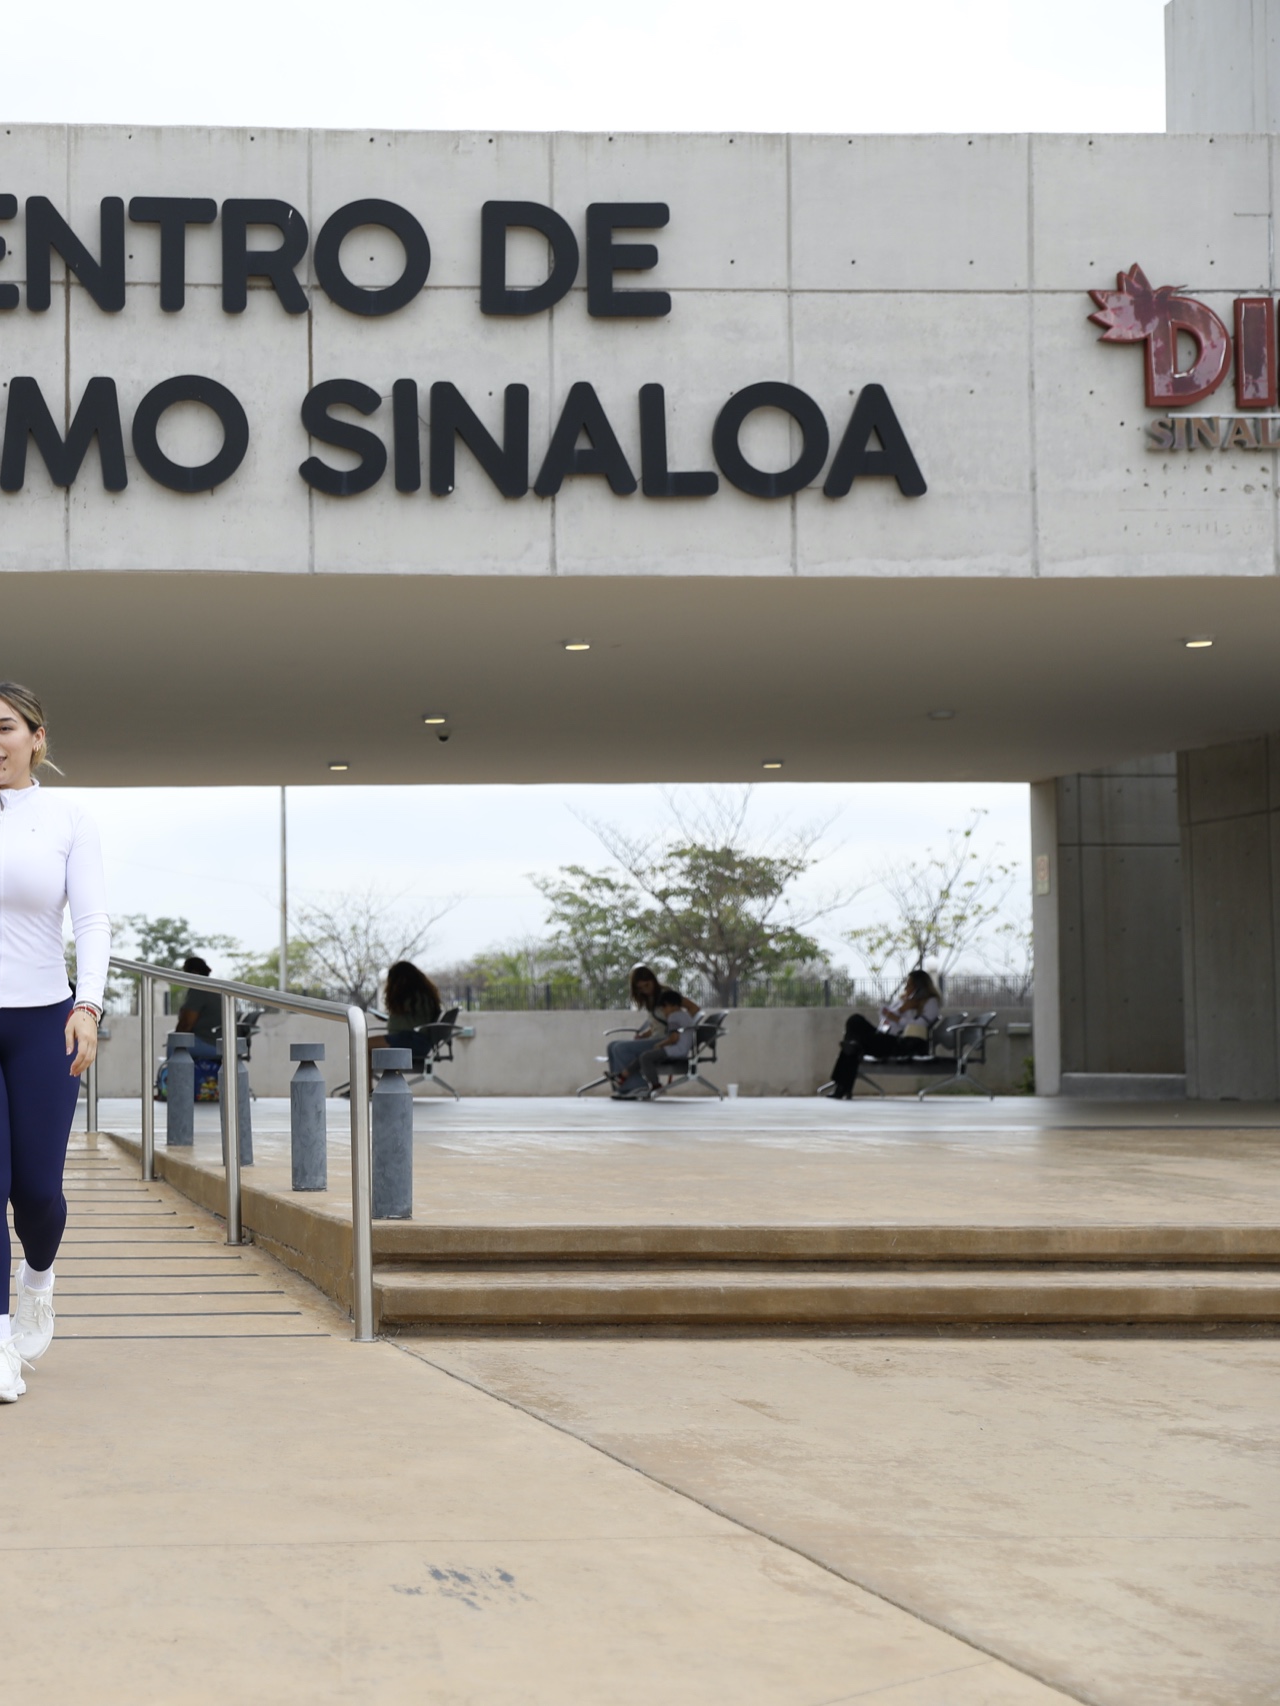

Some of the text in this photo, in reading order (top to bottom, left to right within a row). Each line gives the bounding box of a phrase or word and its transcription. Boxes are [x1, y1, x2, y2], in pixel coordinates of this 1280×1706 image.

[480, 200, 671, 317] DE
[1142, 294, 1280, 408] DI
[299, 378, 927, 498] SINALOA
